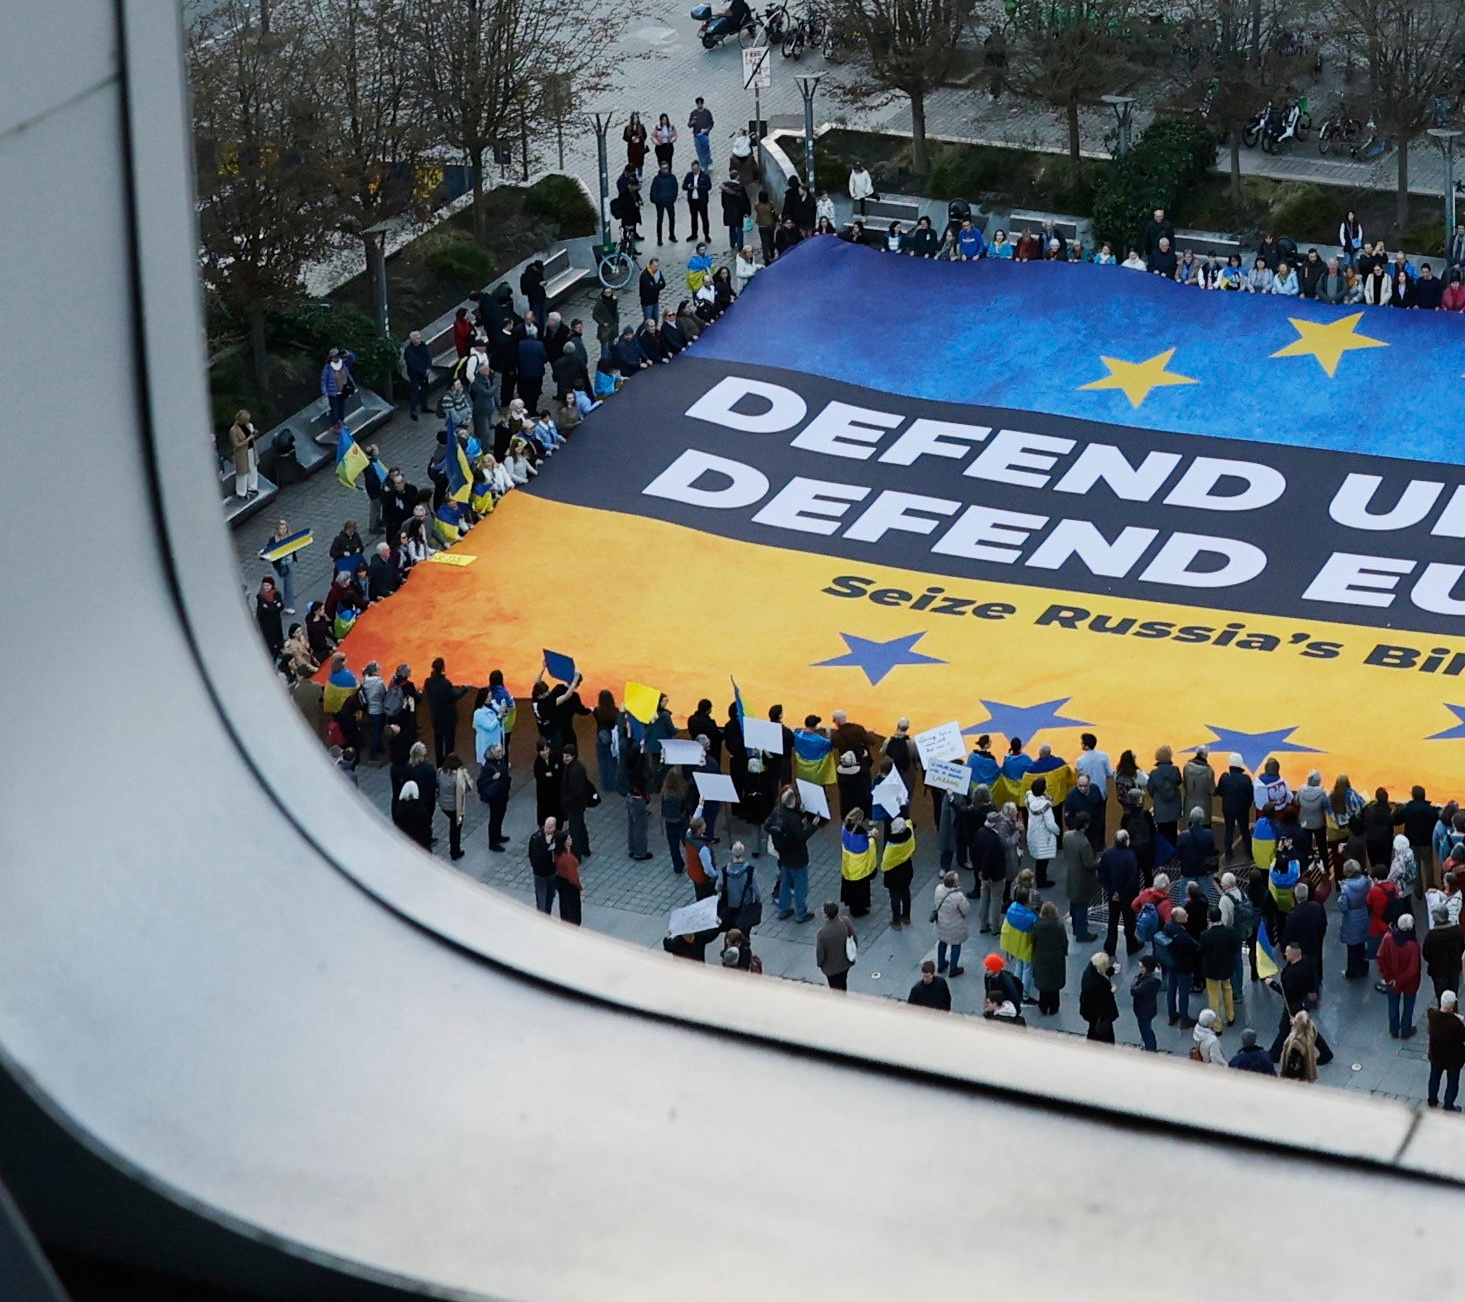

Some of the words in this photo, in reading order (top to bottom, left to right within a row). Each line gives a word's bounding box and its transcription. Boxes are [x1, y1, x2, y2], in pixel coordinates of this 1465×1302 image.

[684, 376, 1287, 512] DEFEND
[642, 448, 1268, 589] DEFEND
[822, 575, 1017, 626] Seize
[1037, 604, 1345, 660] Russia's
